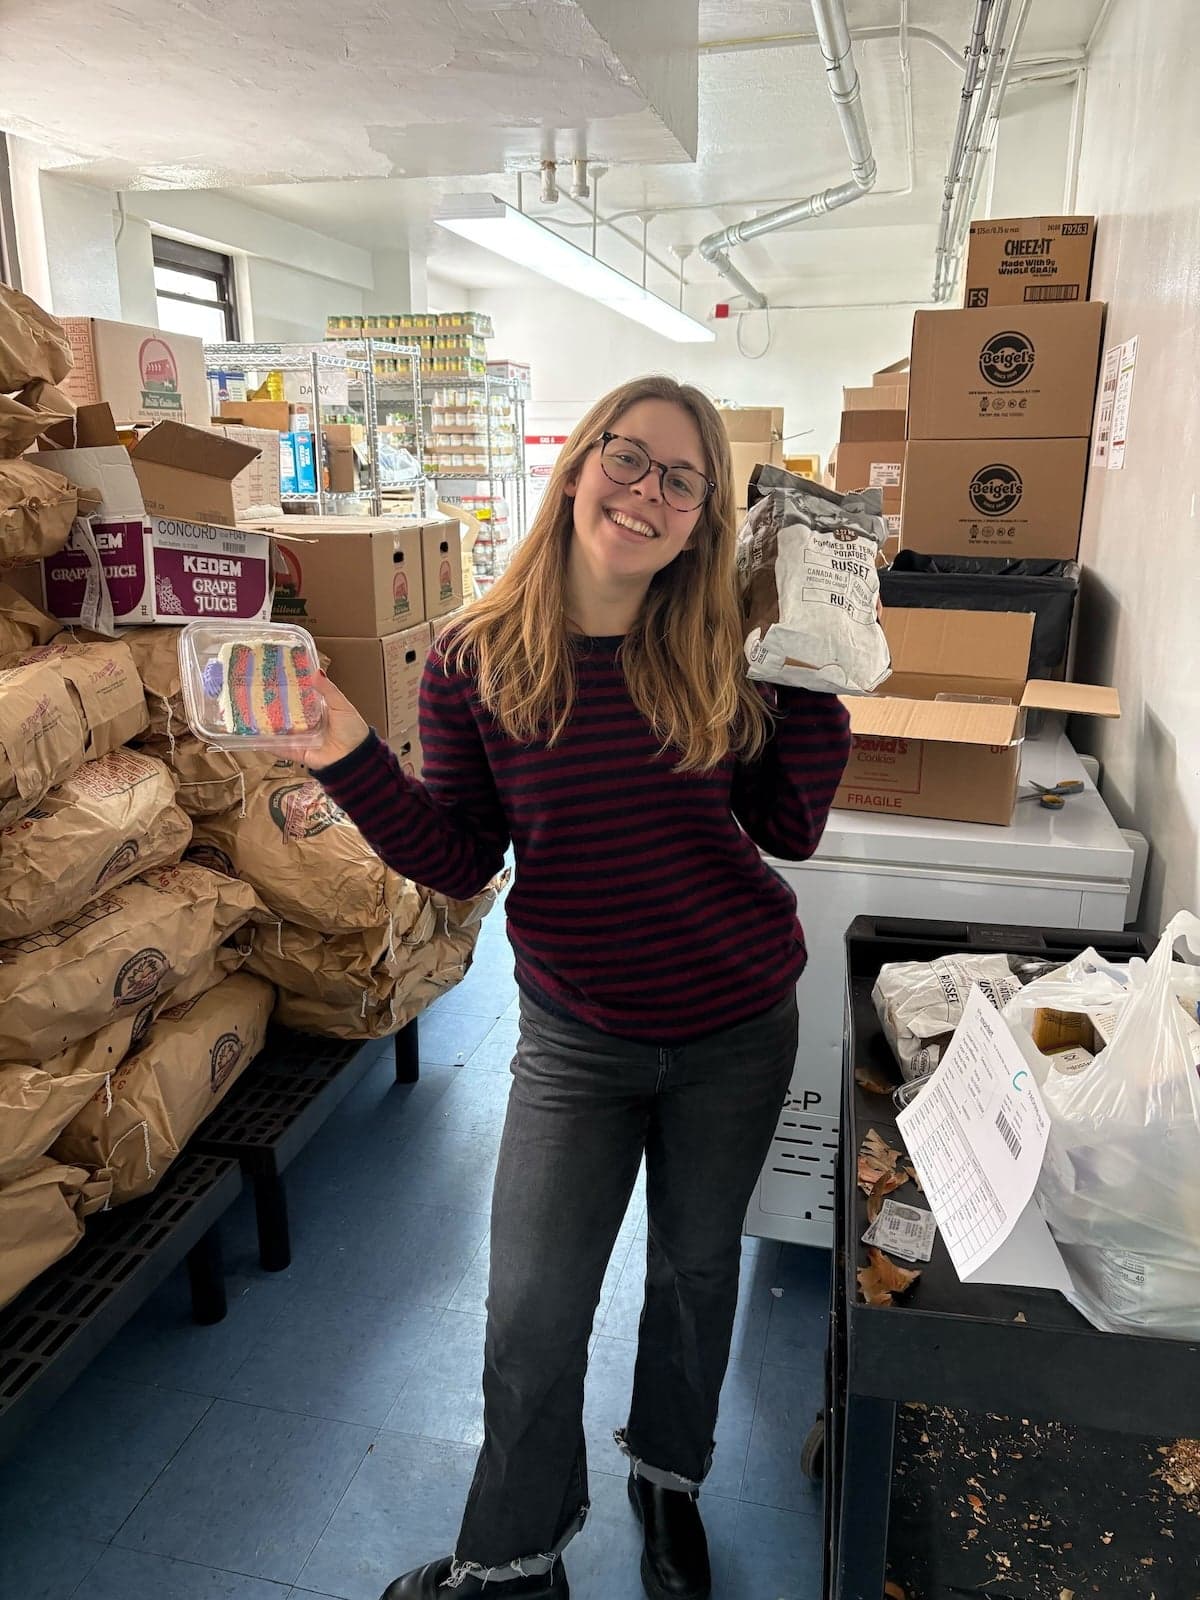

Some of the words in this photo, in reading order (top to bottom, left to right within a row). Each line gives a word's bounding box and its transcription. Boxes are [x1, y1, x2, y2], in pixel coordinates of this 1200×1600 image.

[1063, 224, 1088, 235] 79263
[998, 266, 1028, 275] WHOLE
[1029, 266, 1058, 274] GRAIN
[969, 289, 988, 307] FS
[979, 350, 1035, 368] Beigel's
[299, 385, 329, 395] DARY
[969, 481, 1023, 499] Beigel's
[158, 520, 217, 540] CONCORD
[833, 550, 867, 561] POTATOES
[103, 564, 138, 578] UICE
[183, 555, 242, 577] KEDEM
[831, 559, 870, 580] RUSSET
[192, 578, 238, 597] GRAPE
[194, 595, 238, 613] JUICE
[857, 752, 896, 764] Cookies
[847, 793, 903, 808] FRAGILE
[940, 974, 960, 1004] RUSSET
